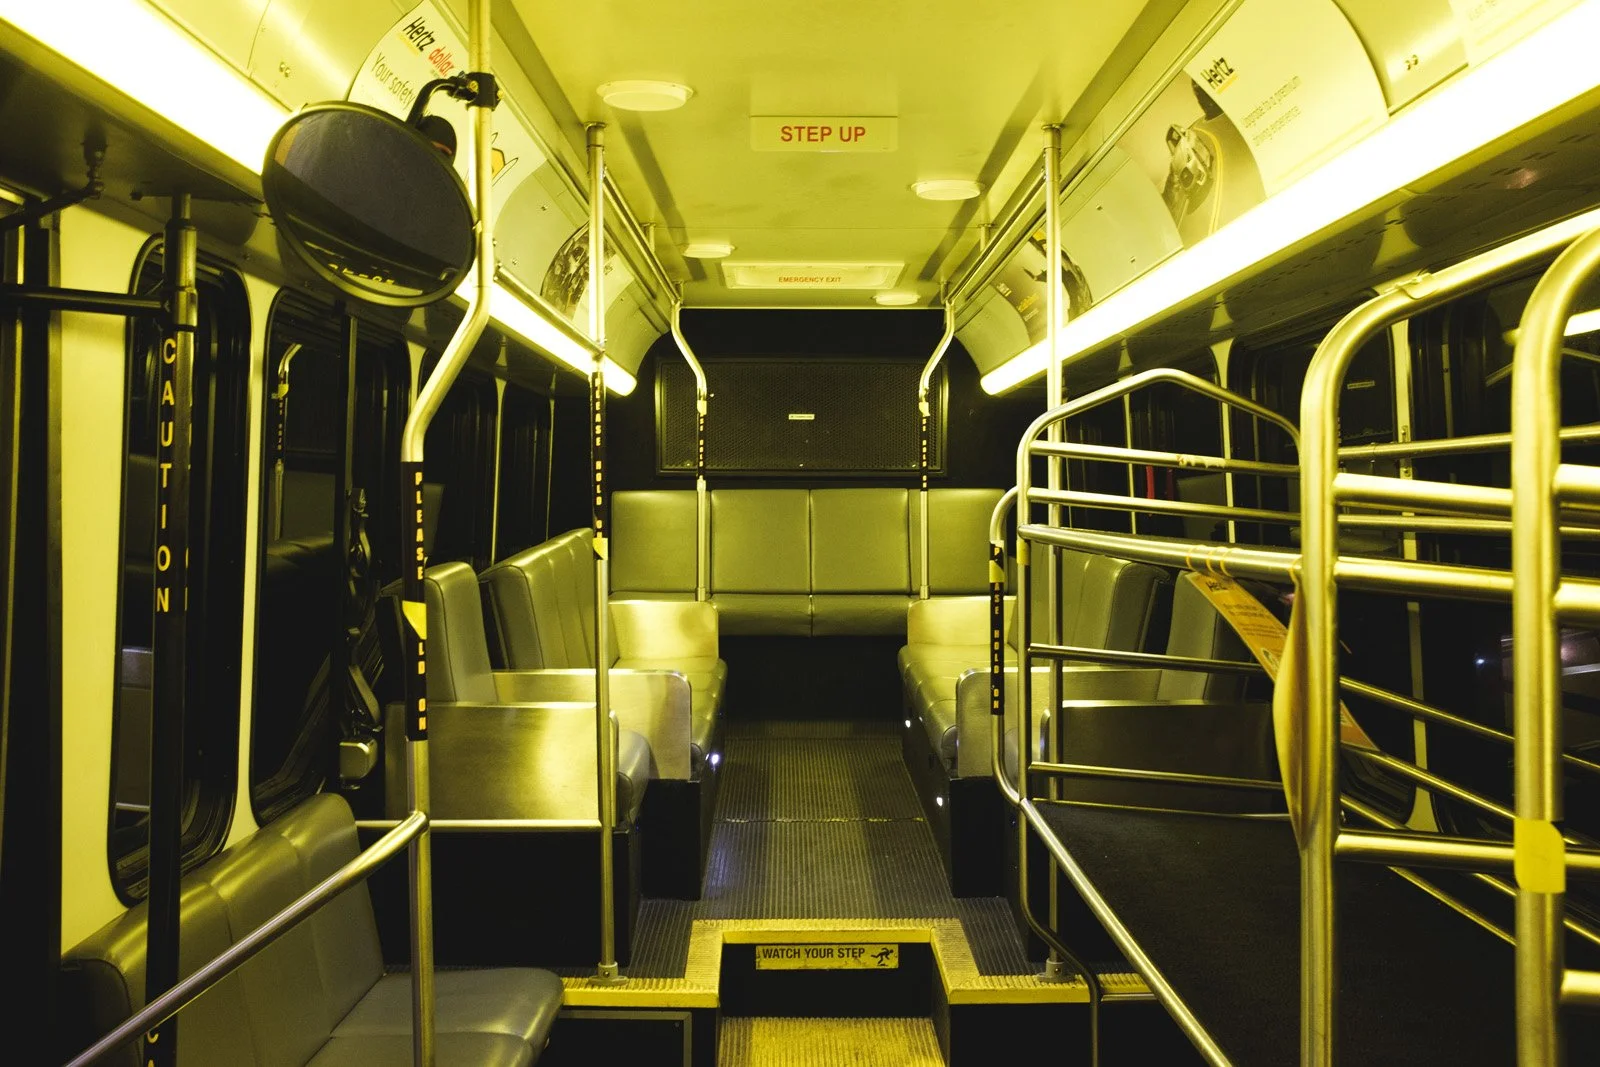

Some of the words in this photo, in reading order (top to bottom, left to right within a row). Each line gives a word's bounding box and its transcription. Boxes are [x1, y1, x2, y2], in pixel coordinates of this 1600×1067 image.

[403, 16, 435, 52] Hertz
[428, 46, 455, 78] dollar
[1200, 57, 1234, 90] Hertz
[371, 52, 393, 85] Your
[388, 76, 415, 111] safety
[781, 125, 832, 142] STEP
[839, 126, 866, 142] UP
[594, 377, 602, 447] PLEASE
[156, 338, 176, 612] CAUTION
[595, 460, 603, 506] HOLD
[415, 471, 424, 580] PLEASE
[418, 698, 427, 730] ON
[993, 688, 999, 709] ON
[762, 948, 801, 959] WATCH
[804, 948, 834, 959] YOUR
[837, 948, 866, 958] STEP
